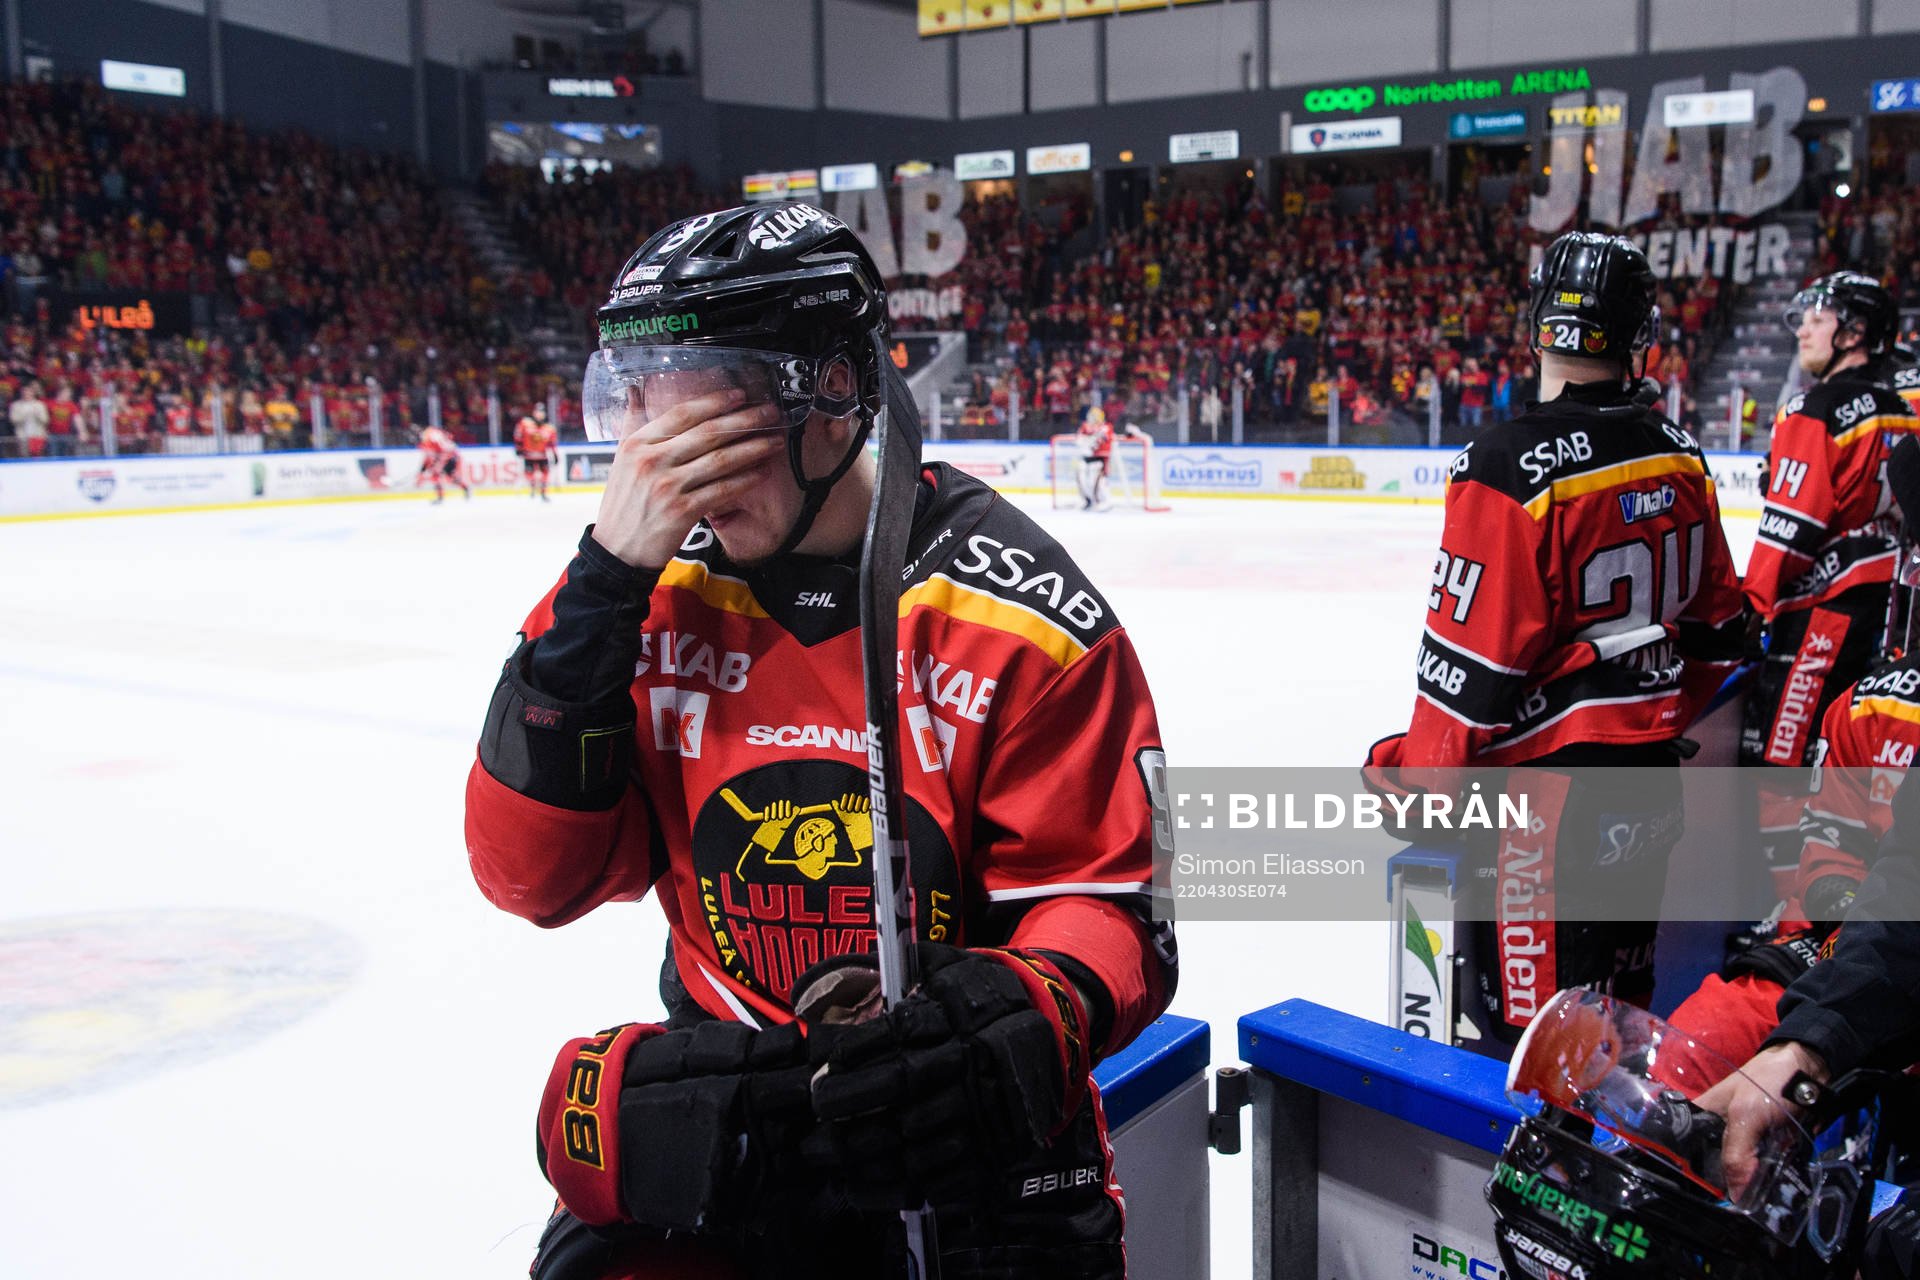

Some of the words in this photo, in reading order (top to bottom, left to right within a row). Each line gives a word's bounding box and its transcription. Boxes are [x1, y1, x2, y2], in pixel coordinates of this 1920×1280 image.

[1304, 86, 1376, 113] coop
[1383, 79, 1501, 106] Norrbotten
[1511, 67, 1591, 95] ARENA
[1640, 225, 1791, 286] ENTER
[793, 289, 850, 308] BAUER
[598, 312, 699, 343] äkarjouren
[1554, 324, 1580, 350] 24
[1835, 393, 1877, 427] SSAB
[1519, 431, 1593, 484] SSAB
[1771, 457, 1808, 499] 14
[794, 591, 837, 608] SHL
[953, 534, 1104, 630] SSAB
[1428, 548, 1485, 624] 24
[660, 630, 751, 693] LKAB
[912, 650, 999, 724] LKAB
[867, 722, 889, 835] BAUER
[719, 871, 873, 924] LULE
[929, 889, 951, 942] 977
[1022, 1165, 1102, 1198] BAUER
[1498, 1161, 1608, 1245] Läkarjou
[1413, 1233, 1497, 1280] DAC
[1503, 1227, 1574, 1273] BAUER
